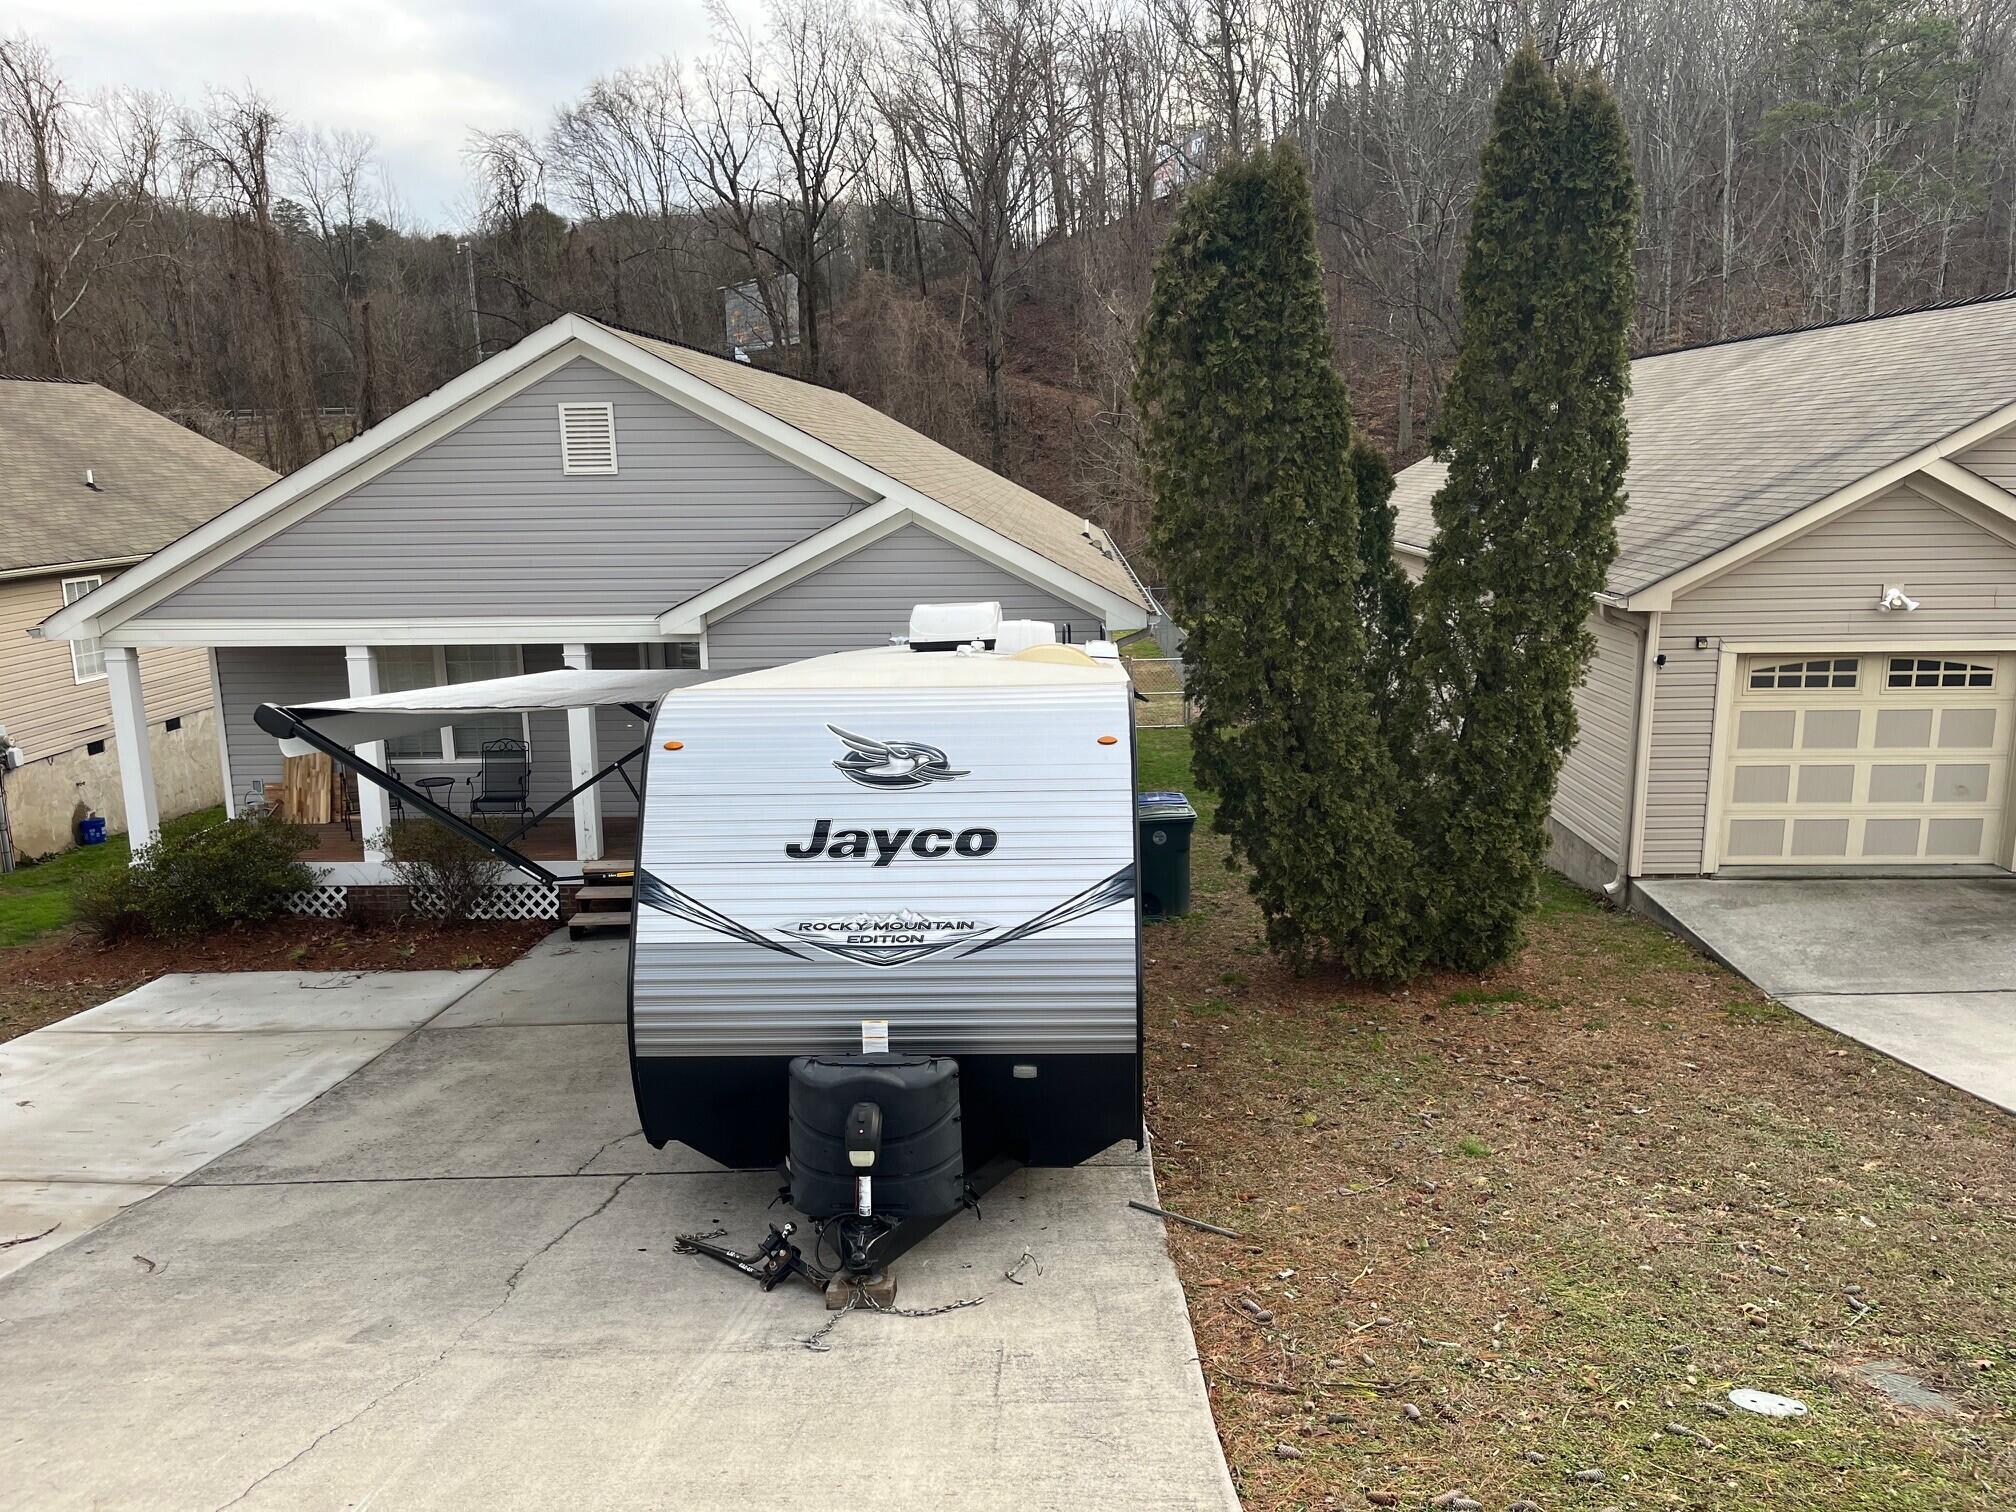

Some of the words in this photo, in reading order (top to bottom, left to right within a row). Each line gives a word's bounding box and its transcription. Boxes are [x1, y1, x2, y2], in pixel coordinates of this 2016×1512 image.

[785, 818, 999, 868] Jayco
[798, 922, 868, 931] ROCKY
[873, 921, 975, 931] MOUNTAIN
[846, 934, 925, 944] EDITION
